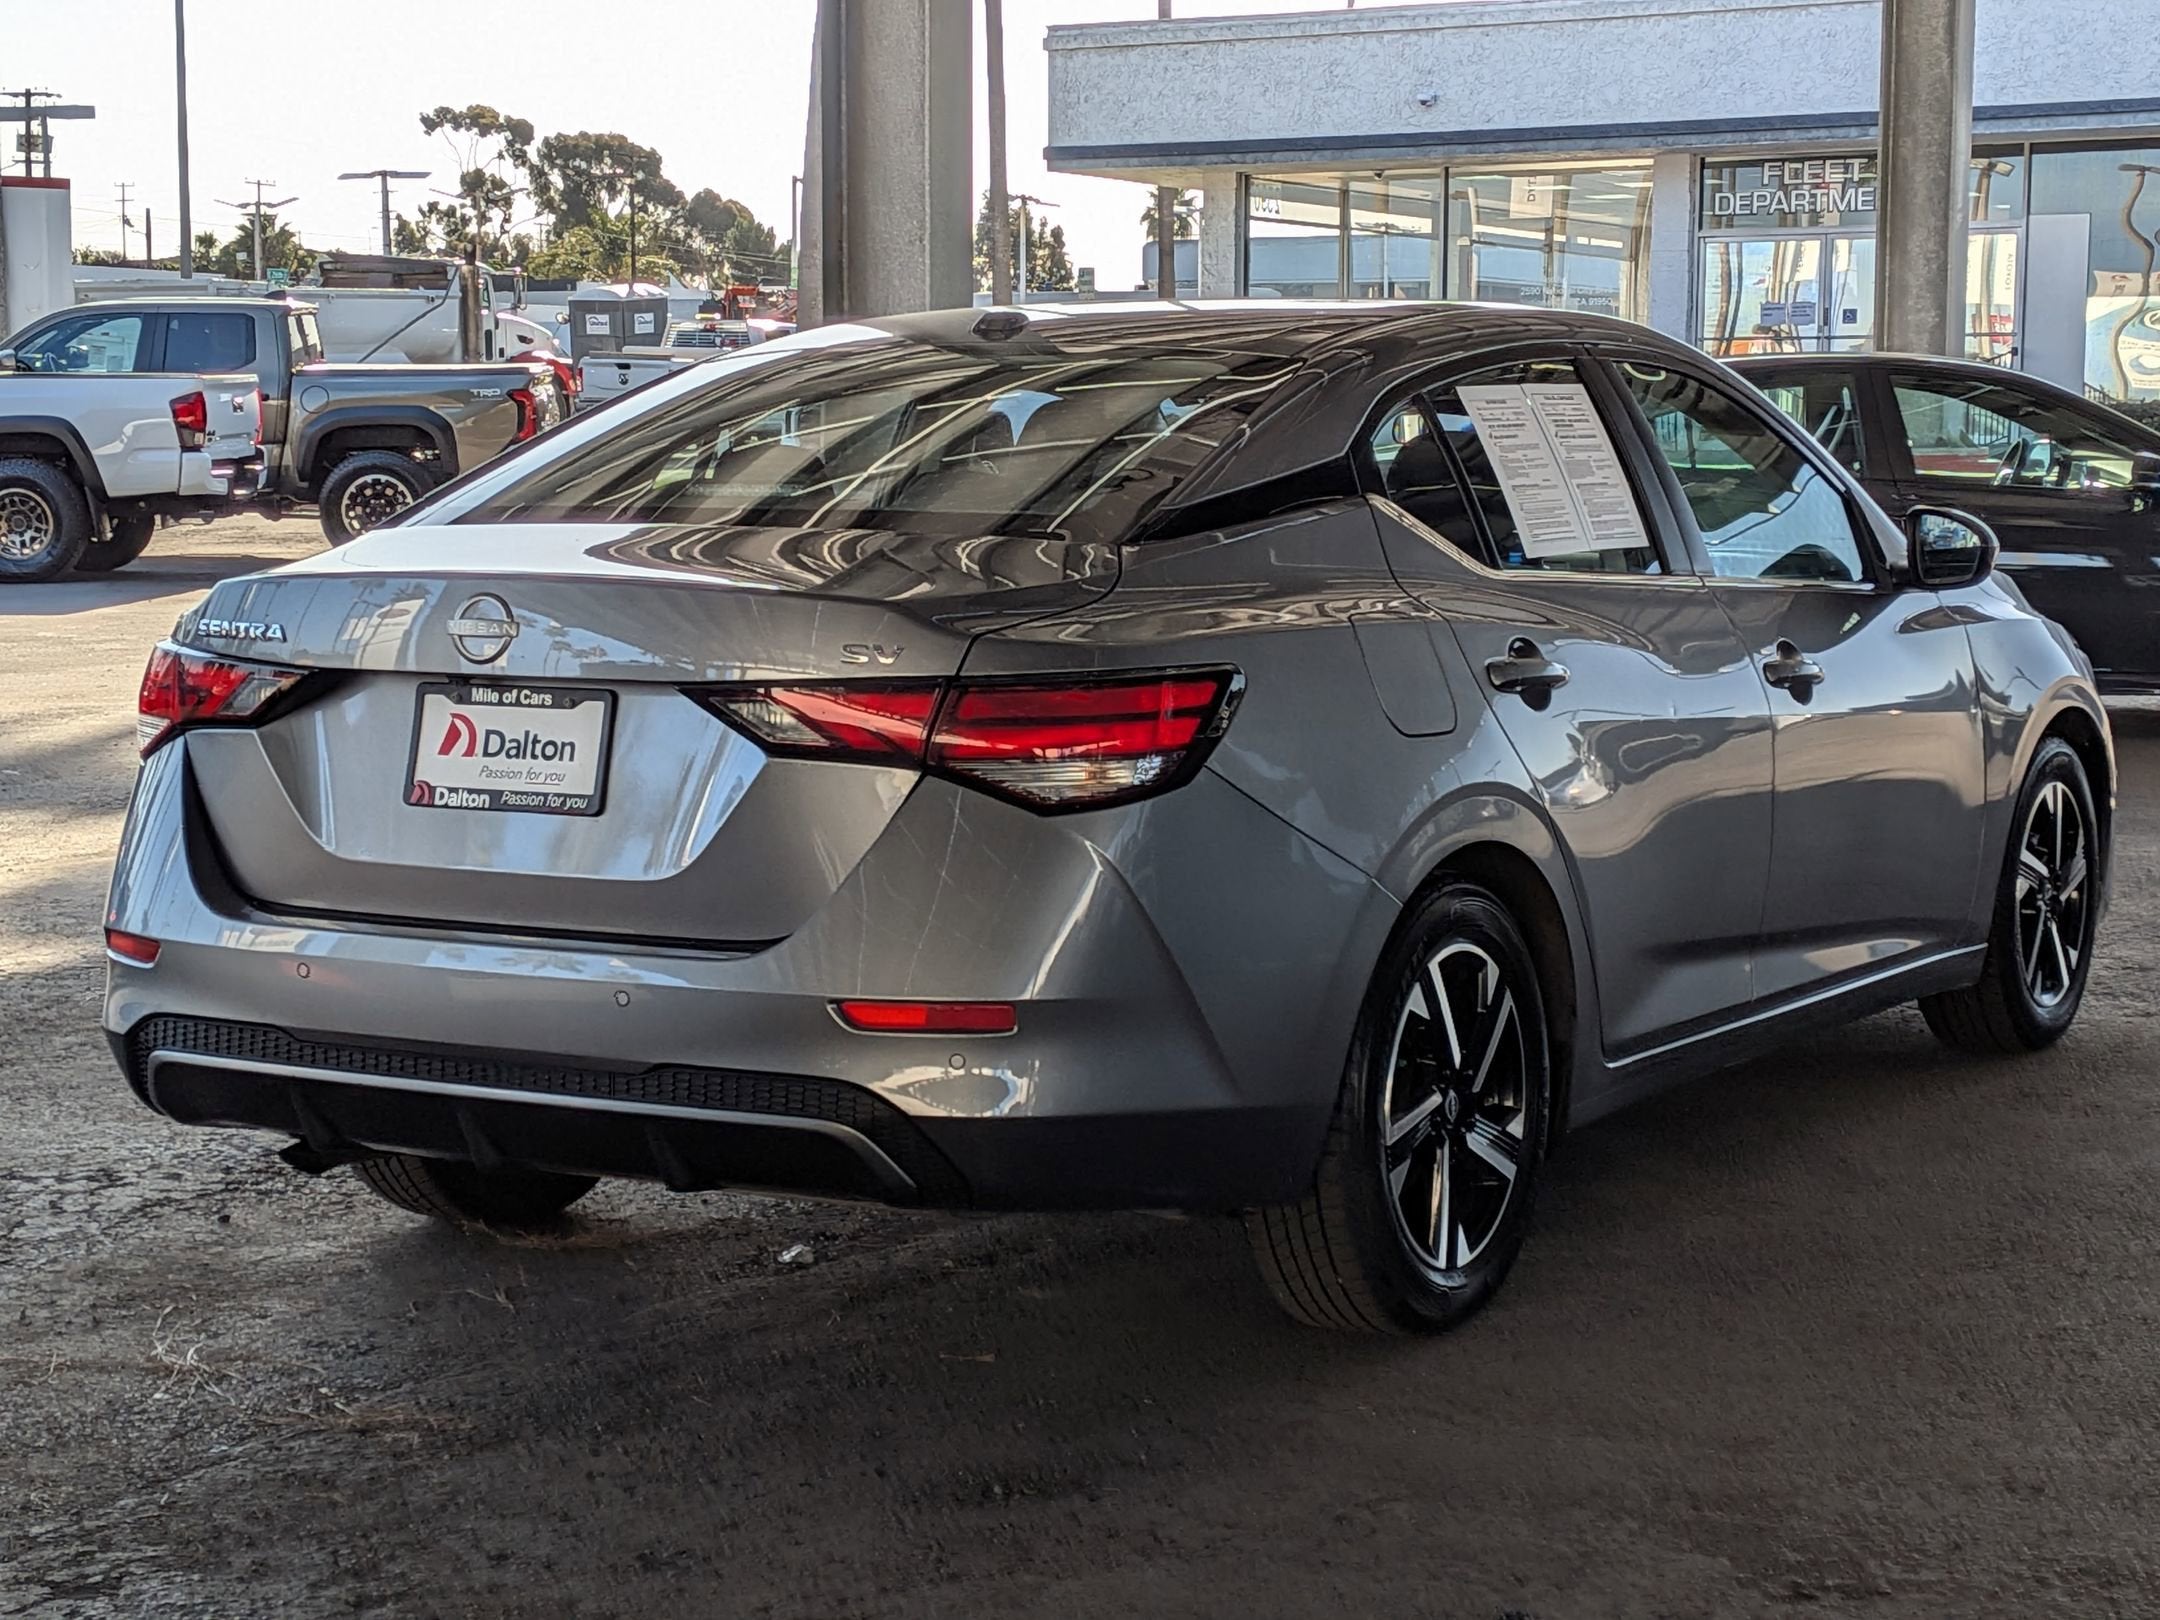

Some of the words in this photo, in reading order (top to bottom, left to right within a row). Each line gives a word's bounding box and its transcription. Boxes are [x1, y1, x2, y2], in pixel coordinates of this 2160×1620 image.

[1762, 159, 1869, 185] FLEET
[1714, 187, 1876, 215] DEPARTME
[470, 388, 501, 397] TRD
[198, 618, 287, 642] SENTRA
[449, 620, 516, 636] NISSAN
[840, 643, 905, 665] SV
[471, 688, 499, 704] Mile
[502, 688, 517, 703] of
[519, 689, 552, 706] Cars
[482, 729, 576, 762] Dalton
[478, 765, 523, 781] Passion
[525, 767, 542, 782] for
[543, 771, 566, 784] you
[434, 786, 490, 809] Dalton
[500, 791, 545, 807] Passion
[546, 794, 563, 808] for
[563, 796, 588, 811] you
